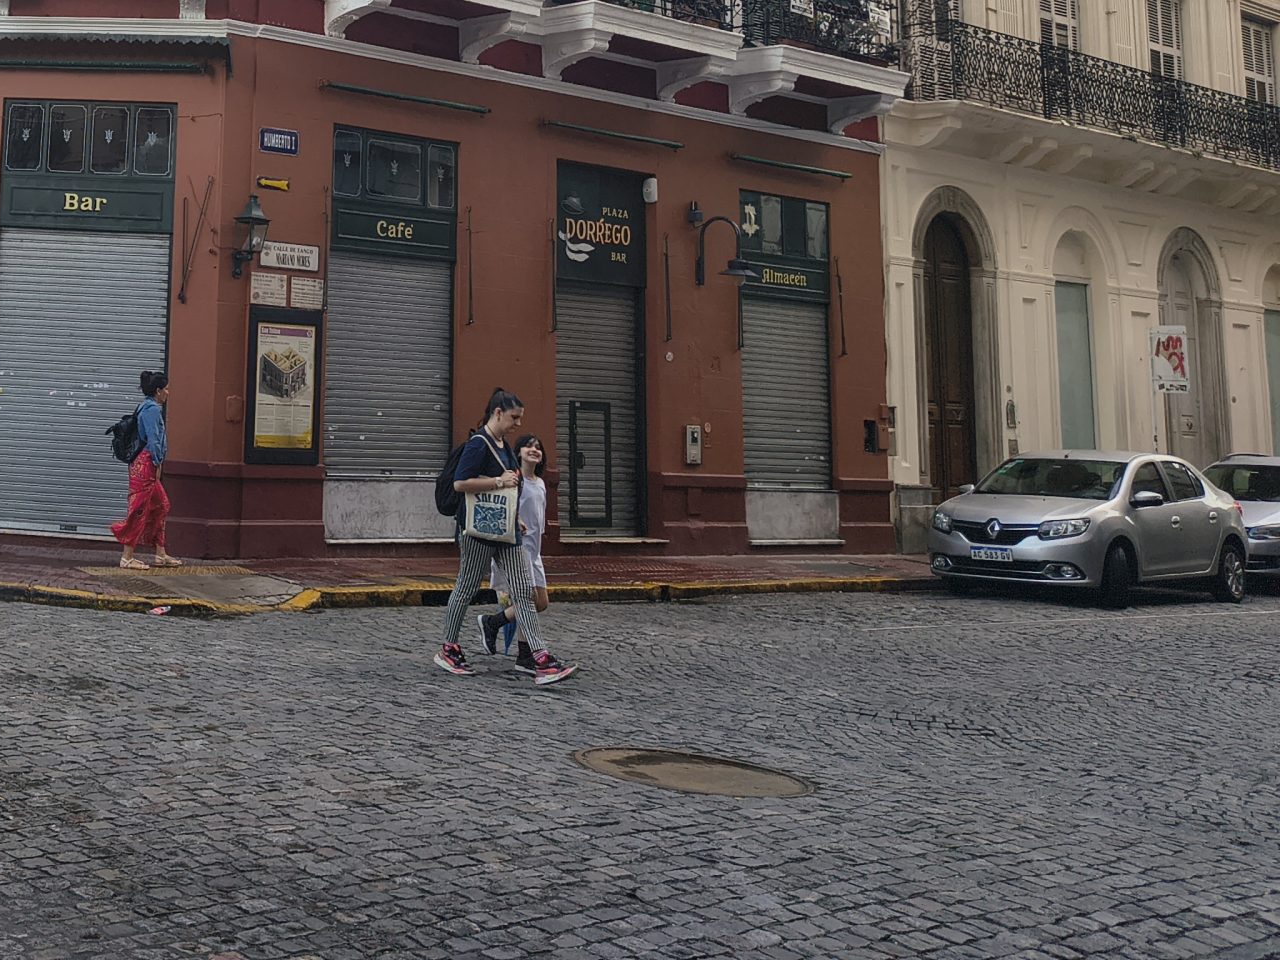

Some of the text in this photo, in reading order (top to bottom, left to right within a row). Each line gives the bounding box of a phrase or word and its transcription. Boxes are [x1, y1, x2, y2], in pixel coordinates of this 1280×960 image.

[264, 132, 291, 150] HUMBERTO
[63, 192, 107, 211] Bar
[602, 207, 629, 219] PLAZA
[376, 219, 414, 239] Café
[565, 217, 631, 246] DORREGO
[611, 252, 627, 264] BAR
[762, 268, 807, 286] Almacén
[972, 550, 983, 559] AC
[984, 551, 999, 560] 583
